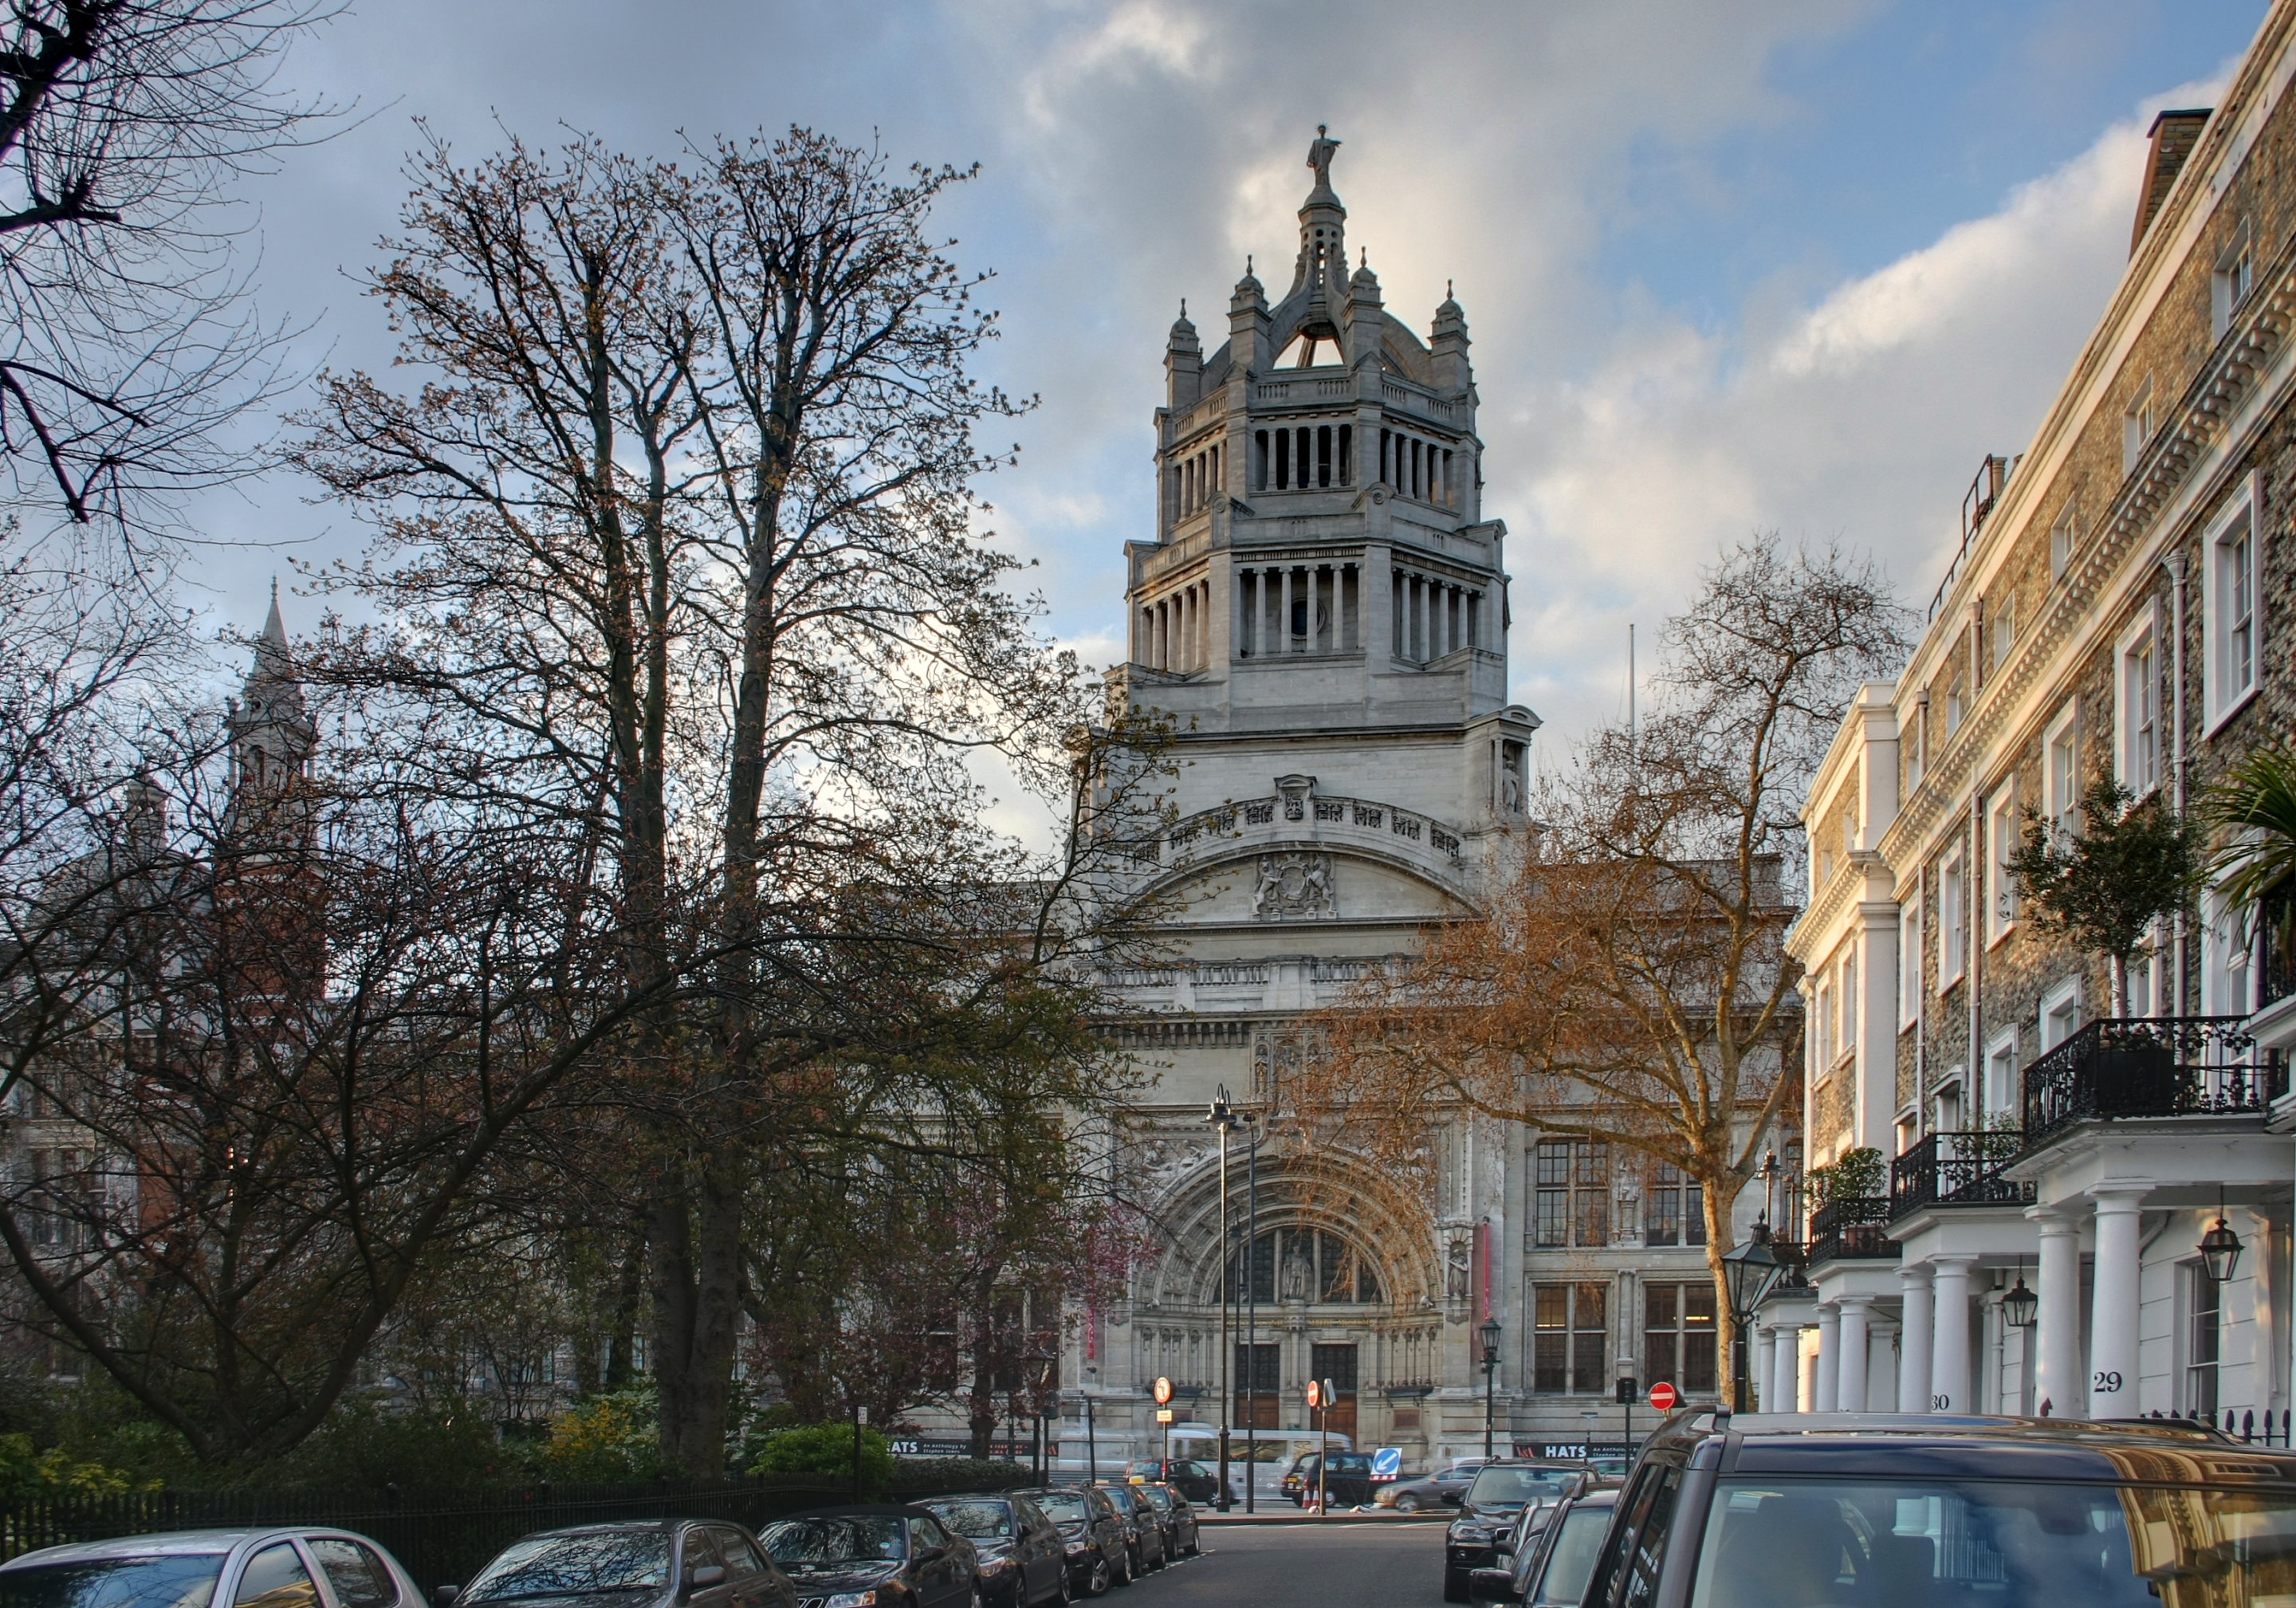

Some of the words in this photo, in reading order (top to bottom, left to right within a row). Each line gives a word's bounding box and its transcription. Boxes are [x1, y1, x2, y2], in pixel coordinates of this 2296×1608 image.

[2094, 1371, 2123, 1393] 29
[1931, 1394, 1950, 1410] 30
[1545, 1445, 1587, 1458] HATS
